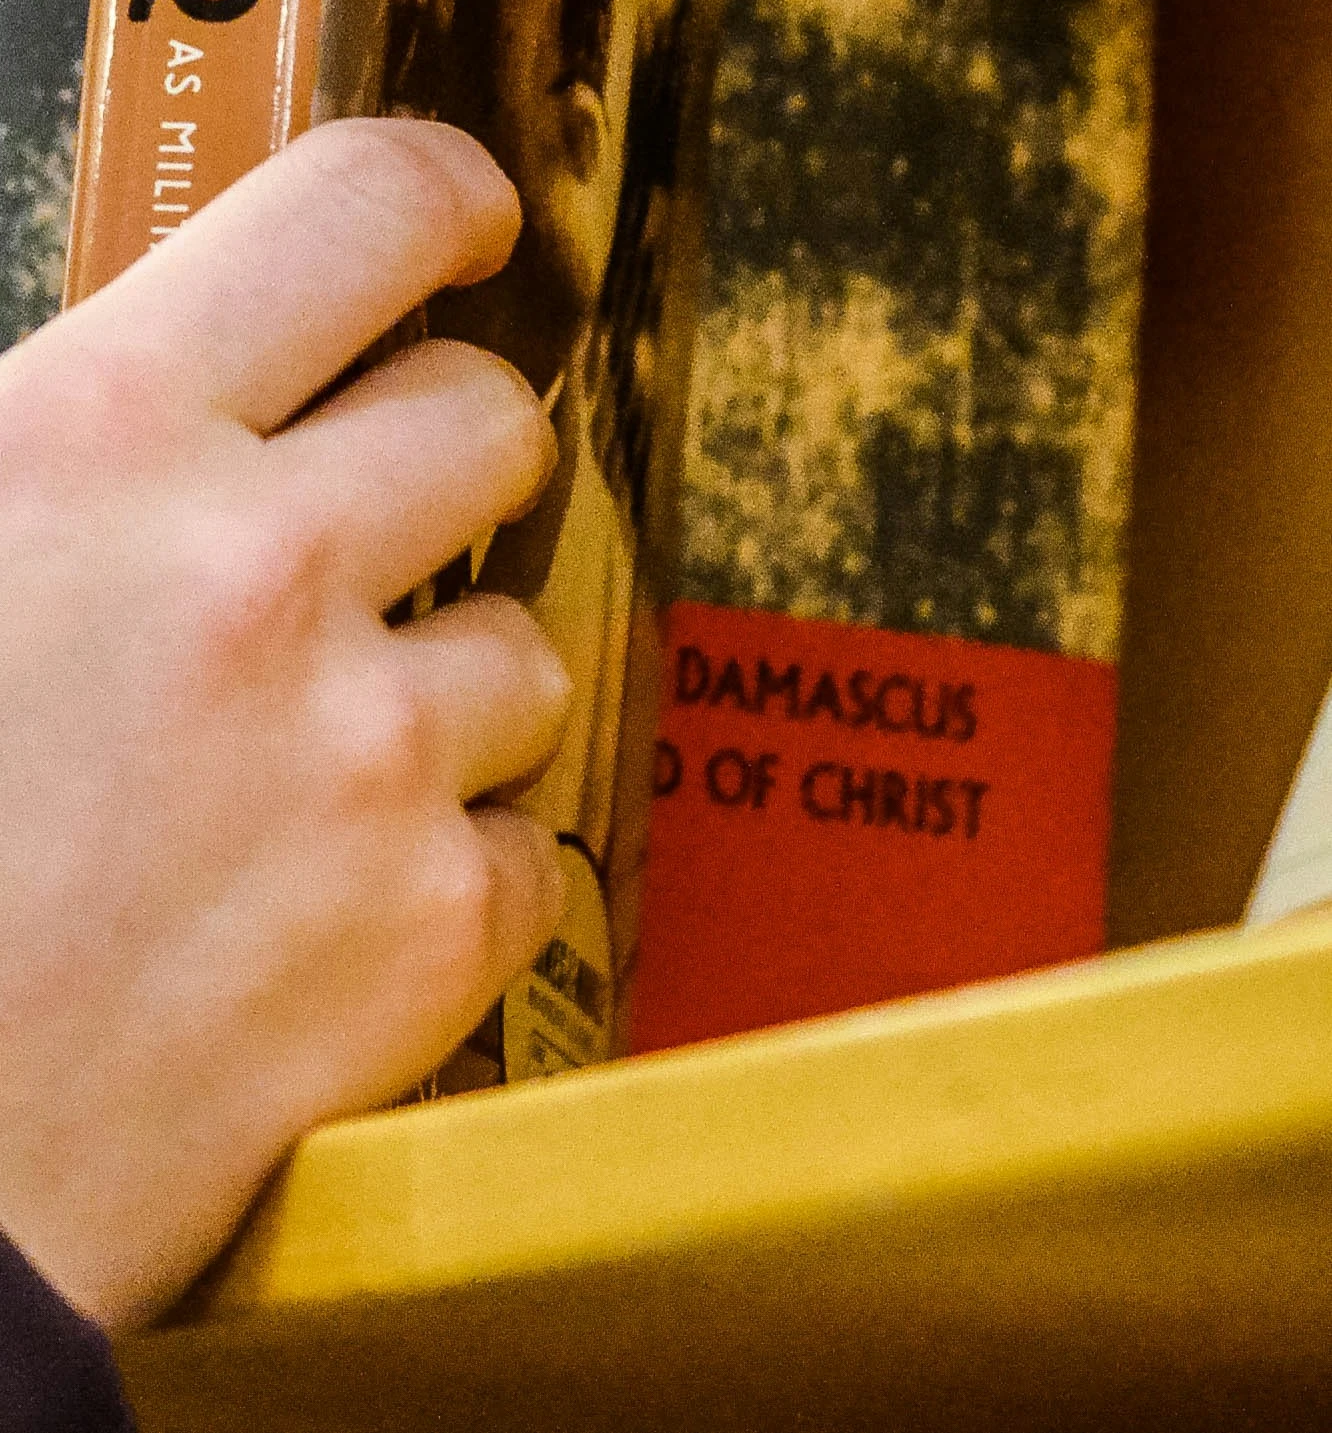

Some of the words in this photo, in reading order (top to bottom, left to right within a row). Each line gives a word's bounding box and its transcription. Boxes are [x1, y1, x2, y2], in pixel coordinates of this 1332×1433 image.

[164, 38, 205, 96] AS
[148, 121, 198, 250] MILIT
[674, 645, 979, 744] DAMASCUS
[705, 748, 780, 810] OF
[800, 761, 992, 841] CHRIST
